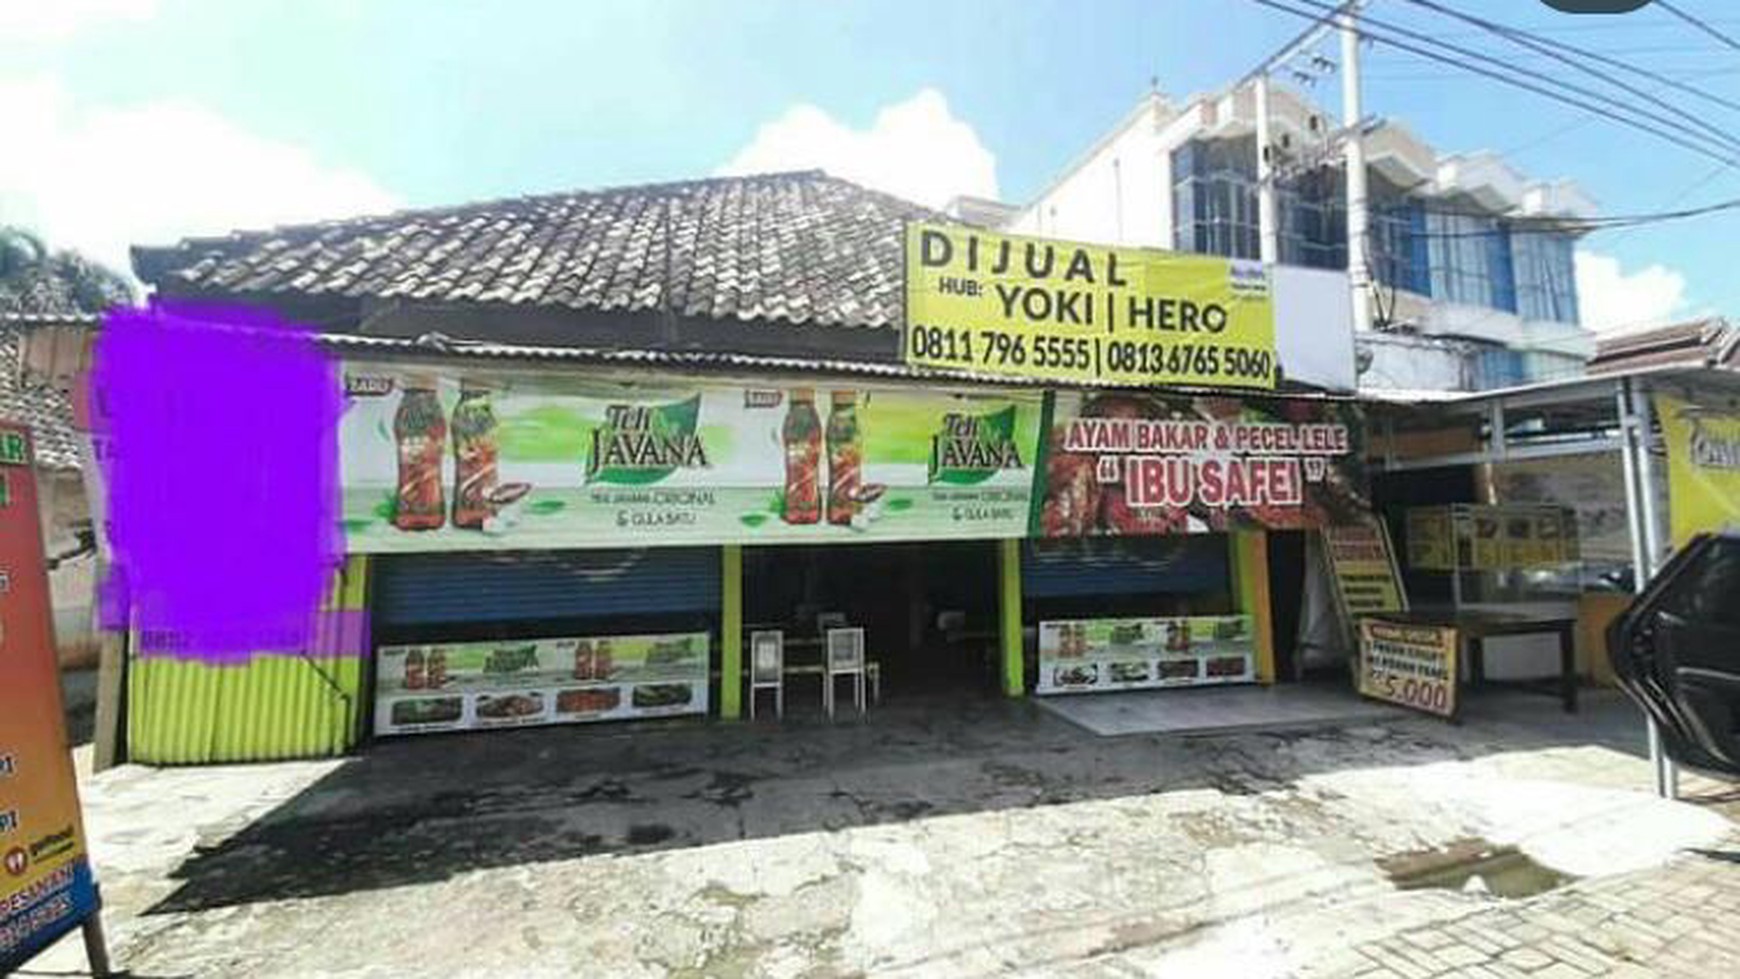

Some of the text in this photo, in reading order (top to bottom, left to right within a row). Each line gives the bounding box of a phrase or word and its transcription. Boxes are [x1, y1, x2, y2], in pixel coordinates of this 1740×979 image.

[921, 230, 1126, 287] DIJUAL
[939, 277, 983, 297] HUB:
[996, 284, 1093, 325] YOKI
[1129, 297, 1227, 333] HERO
[912, 325, 973, 363] 0811
[981, 331, 1026, 365] 796
[1033, 335, 1091, 370] 5555
[1108, 341, 1163, 375] 0813
[1166, 344, 1219, 376] 6765
[1224, 347, 1270, 380] 5060
[586, 428, 711, 476] JAVANA
[930, 435, 1023, 478] JAVANA
[1068, 420, 1347, 452] AYAM BAKAR & PECEL LELE
[1128, 456, 1194, 505] IBU
[1199, 457, 1301, 505] SAFEI
